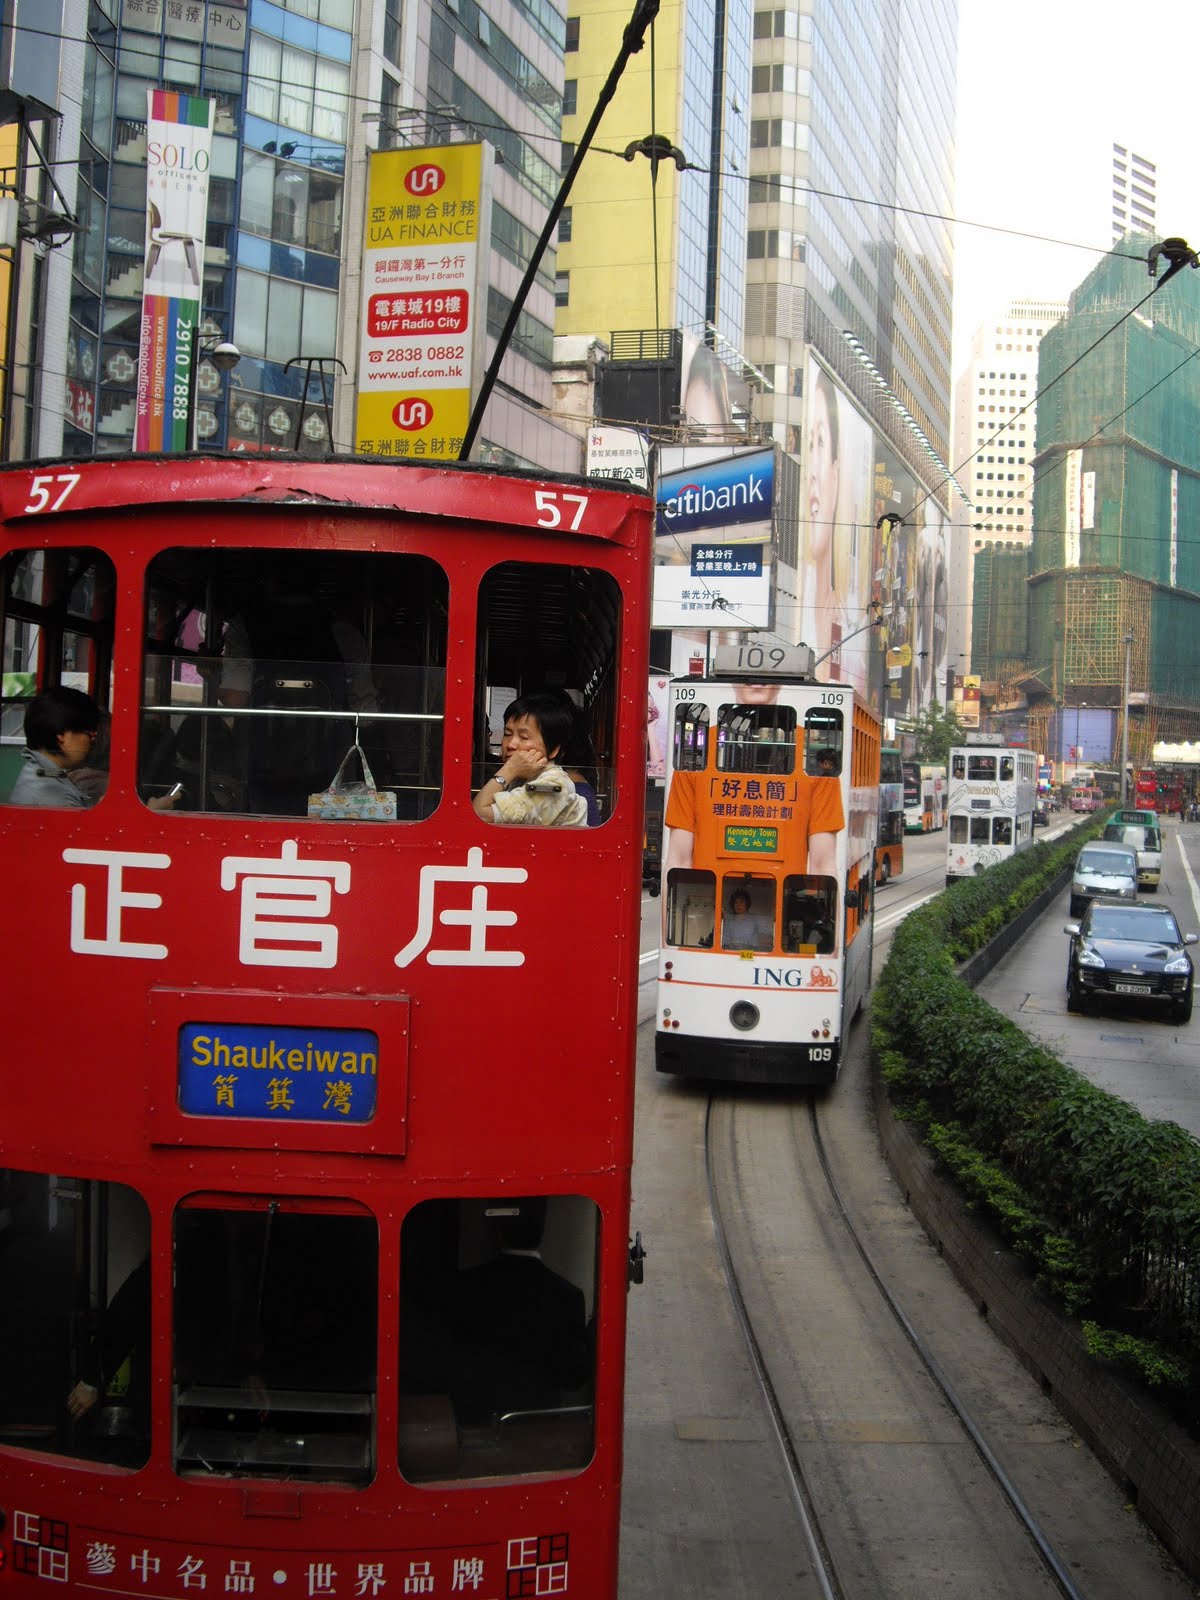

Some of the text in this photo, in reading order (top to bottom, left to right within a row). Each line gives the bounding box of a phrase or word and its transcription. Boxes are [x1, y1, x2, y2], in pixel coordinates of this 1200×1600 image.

[148, 142, 209, 173] SOLO
[158, 169, 197, 181] offices
[371, 200, 475, 223] 亞洲聯合財務
[370, 220, 475, 242] UA FINANCE
[374, 255, 466, 273] 銅鑼灣第一分行
[375, 275, 413, 284] Causeway
[415, 274, 429, 282] Bay
[437, 271, 465, 279] Branch
[375, 296, 461, 317] 電業城19樓
[375, 317, 461, 331] 19/F Radio City
[386, 346, 464, 363] 2838 0882
[153, 316, 165, 417] www.solooffice.hk
[172, 318, 192, 420] 2910 7888
[368, 365, 462, 380] www.uaf.com.hk
[360, 437, 464, 455] 亞洲聯合財務
[590, 467, 645, 479] 成立新公司
[24, 474, 81, 513] 57
[664, 474, 763, 518] citibank
[535, 490, 588, 531] 57
[696, 549, 733, 559] 全線分行
[696, 561, 757, 571] 營業至晚上7時
[681, 590, 721, 600] 崇光分行
[738, 648, 785, 668] 109
[675, 688, 696, 700] 109
[821, 693, 844, 705] 109
[712, 803, 793, 819] 理財壽險計劃
[727, 827, 777, 837] Kennedy Town
[62, 840, 528, 969] 正官庄
[752, 967, 803, 987] ING
[191, 1035, 377, 1075] Shaukeiwan
[809, 1048, 832, 1061] 109
[212, 1073, 354, 1115] 筲箕灣
